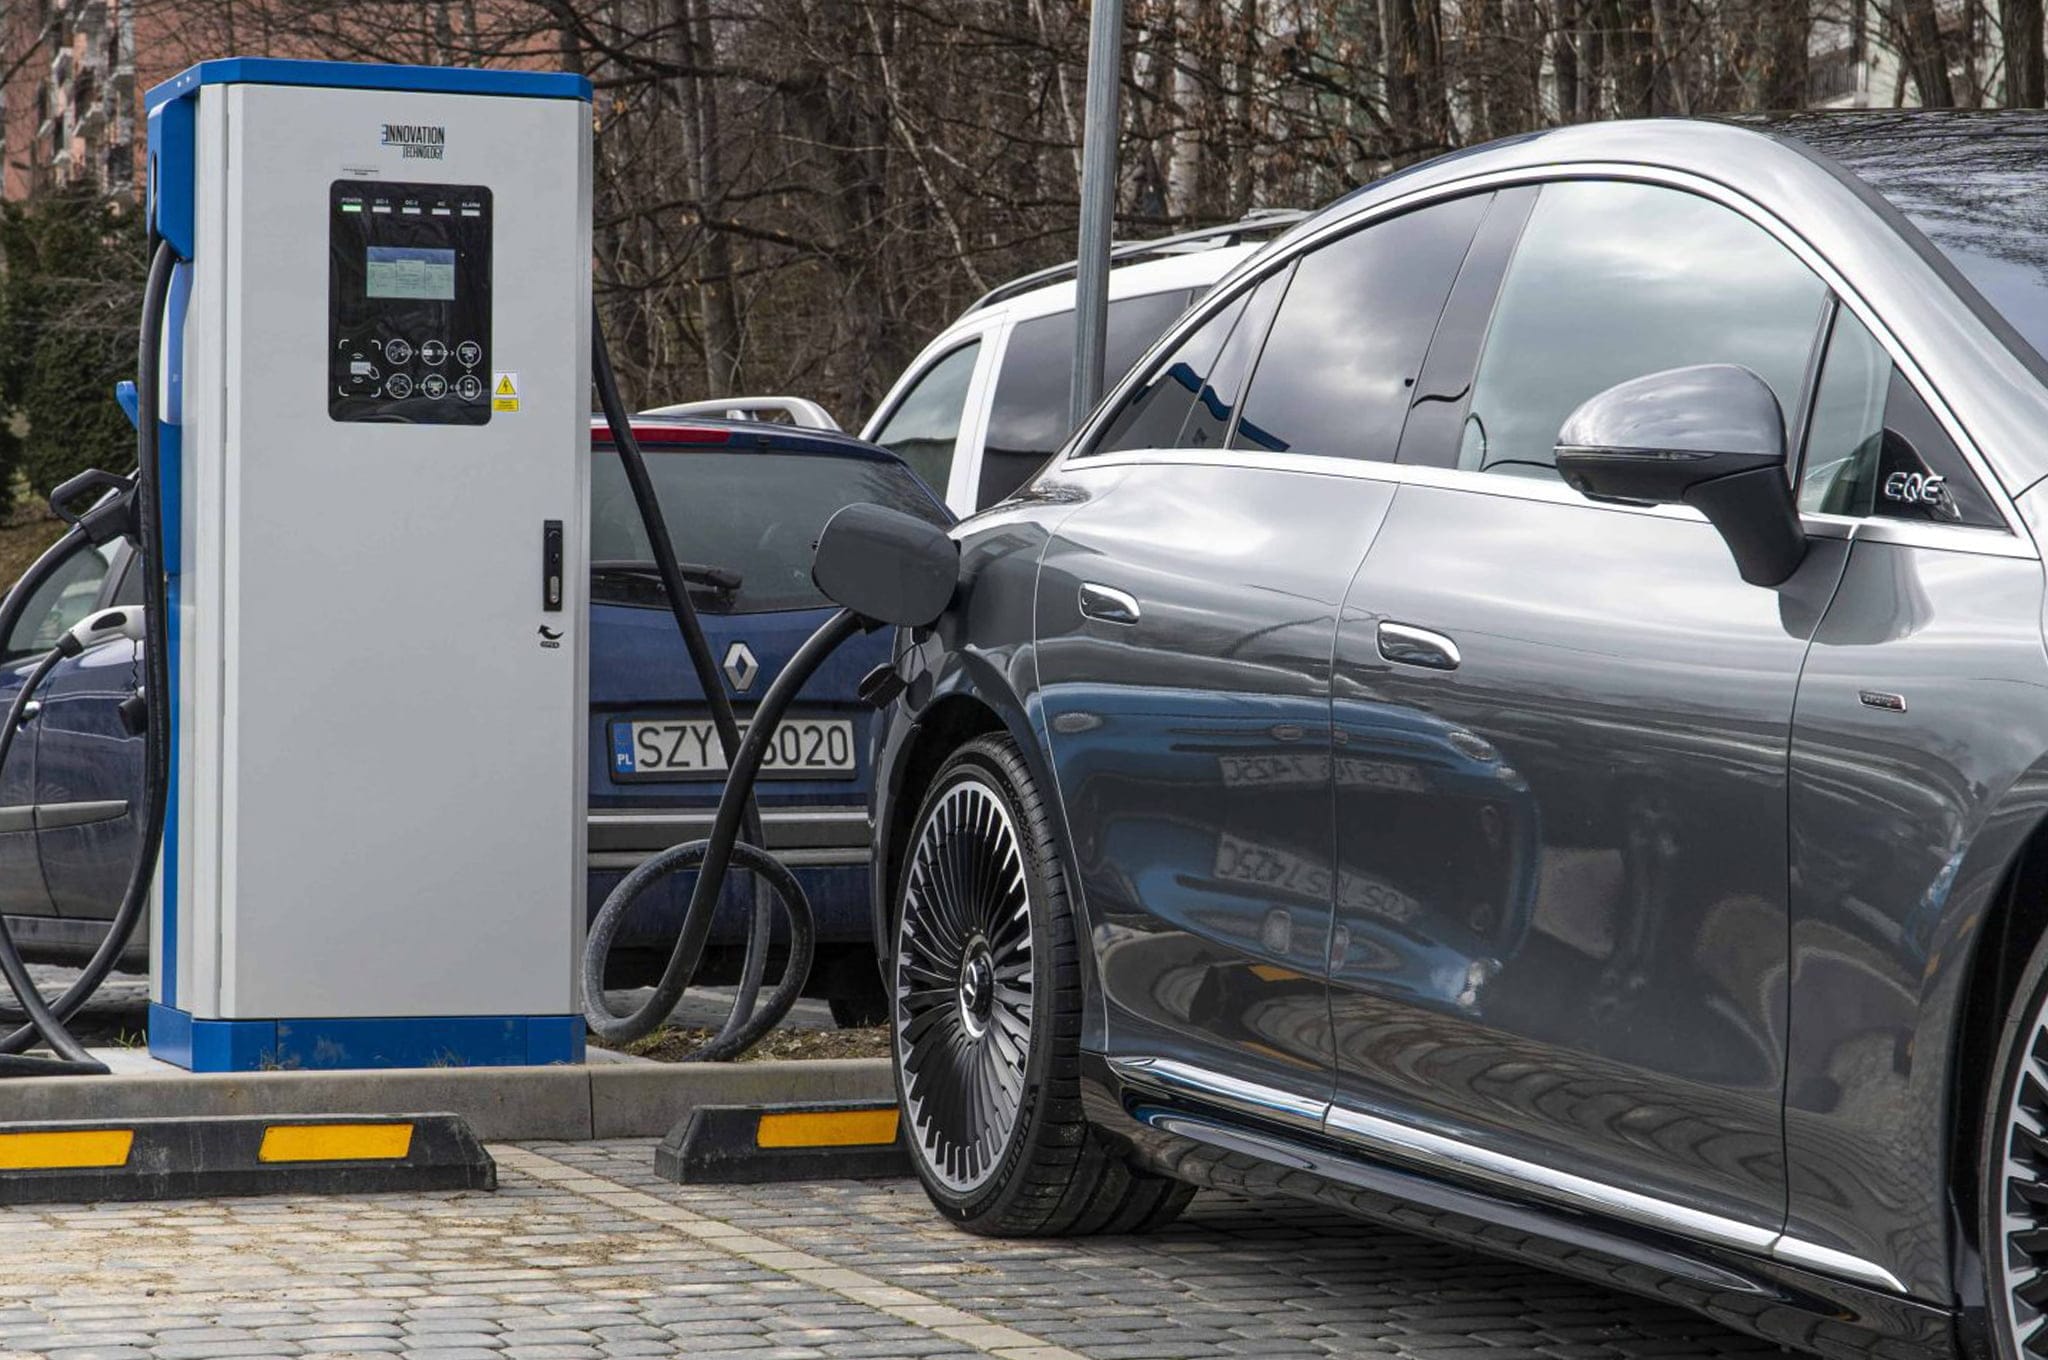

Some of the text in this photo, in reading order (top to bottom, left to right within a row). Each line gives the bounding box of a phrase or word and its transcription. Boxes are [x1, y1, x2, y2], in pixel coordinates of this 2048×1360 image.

[1885, 472, 1944, 504] EQE
[616, 753, 632, 765] PL
[636, 725, 713, 768] SZY
